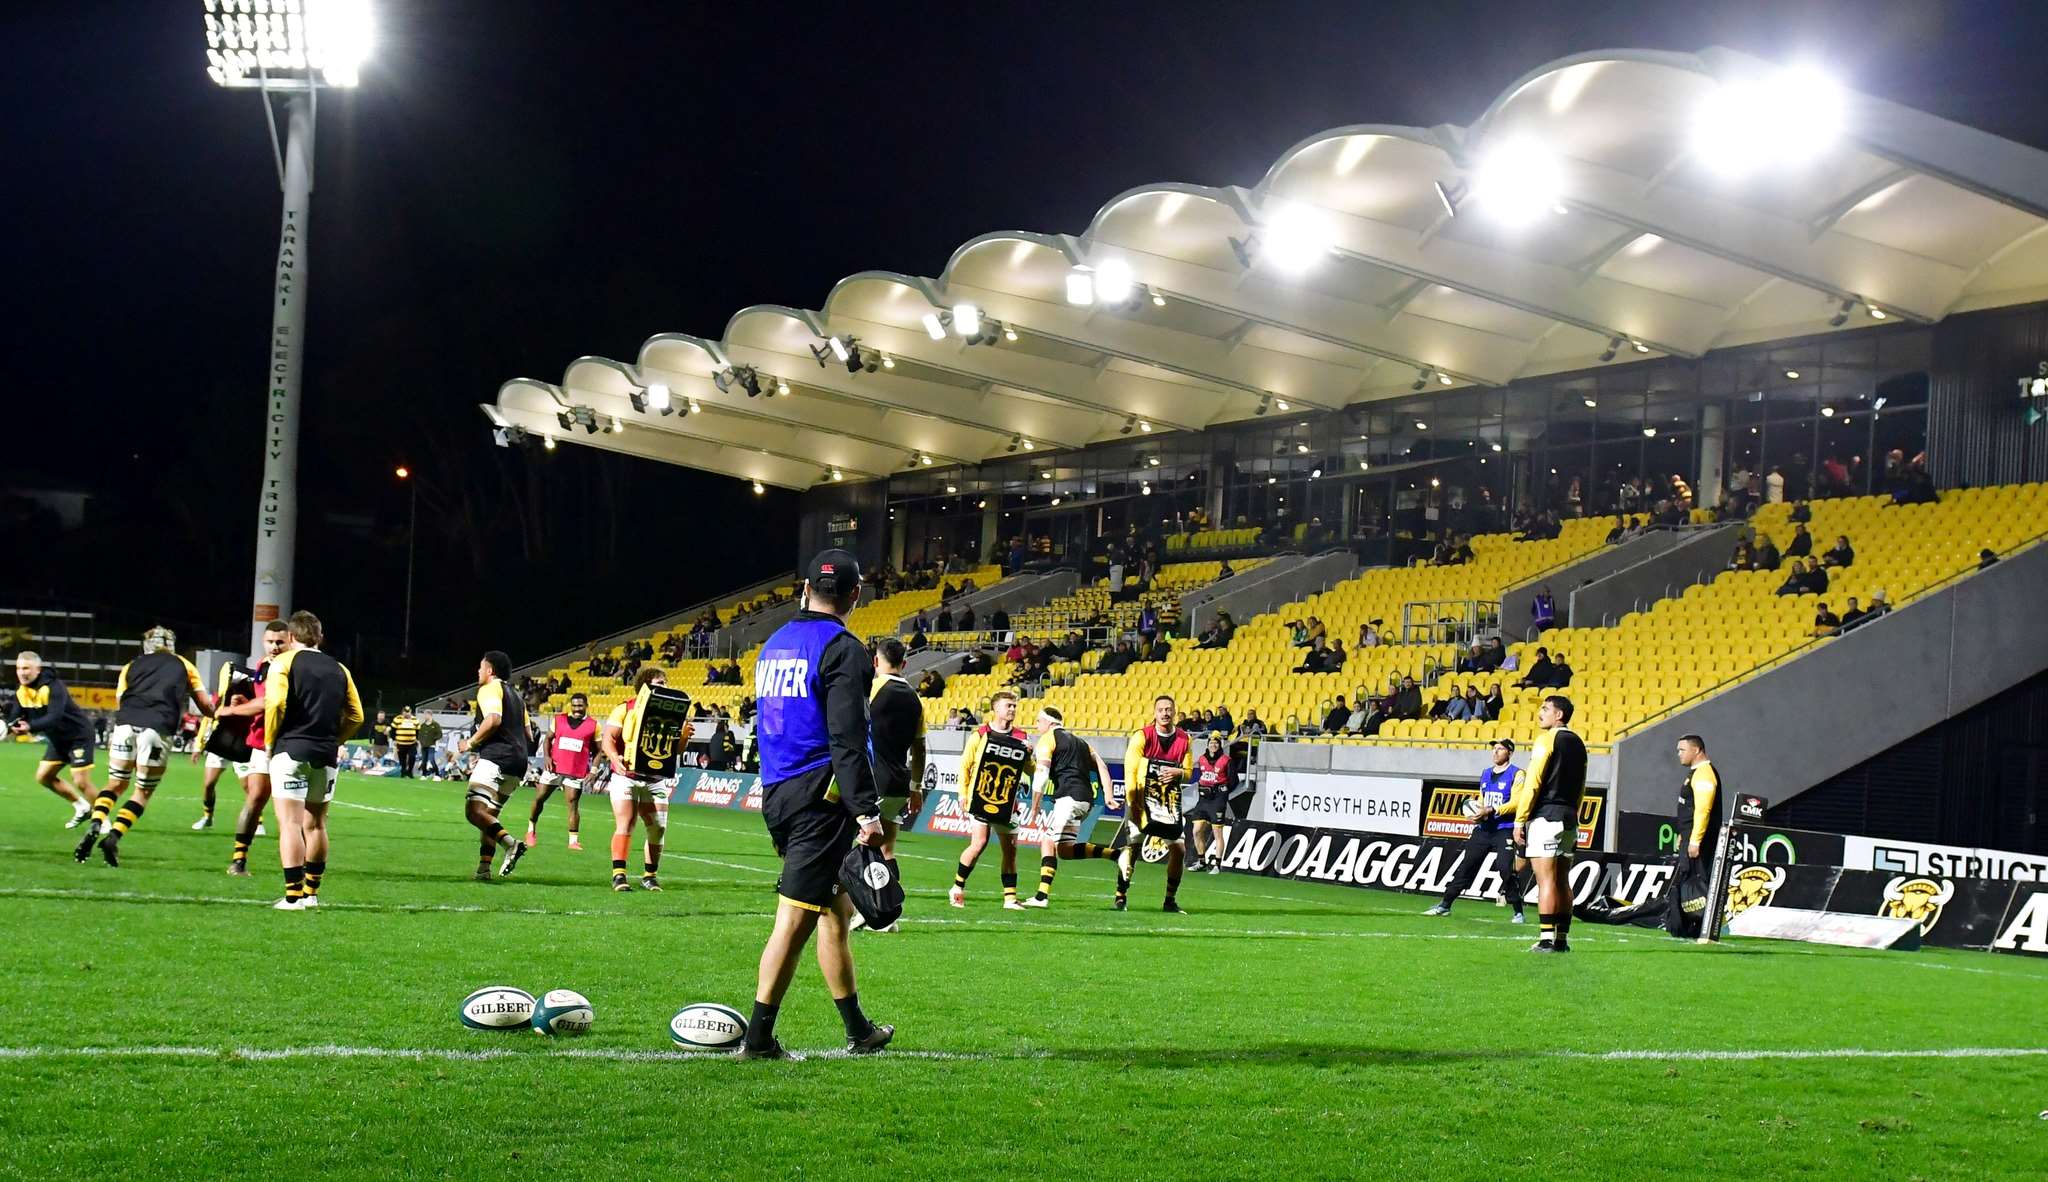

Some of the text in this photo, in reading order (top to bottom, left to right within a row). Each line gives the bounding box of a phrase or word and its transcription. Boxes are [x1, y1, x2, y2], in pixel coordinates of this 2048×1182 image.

[264, 210, 298, 537] TARANAKI ELECTRICITY TRUST
[756, 659, 808, 698] WATER
[682, 750, 699, 767] CMK
[1291, 794, 1412, 818] FORSYTH BARR
[1740, 805, 1763, 817] CMK
[470, 1001, 532, 1016] GILBERT
[674, 1017, 737, 1034] GILBERT
